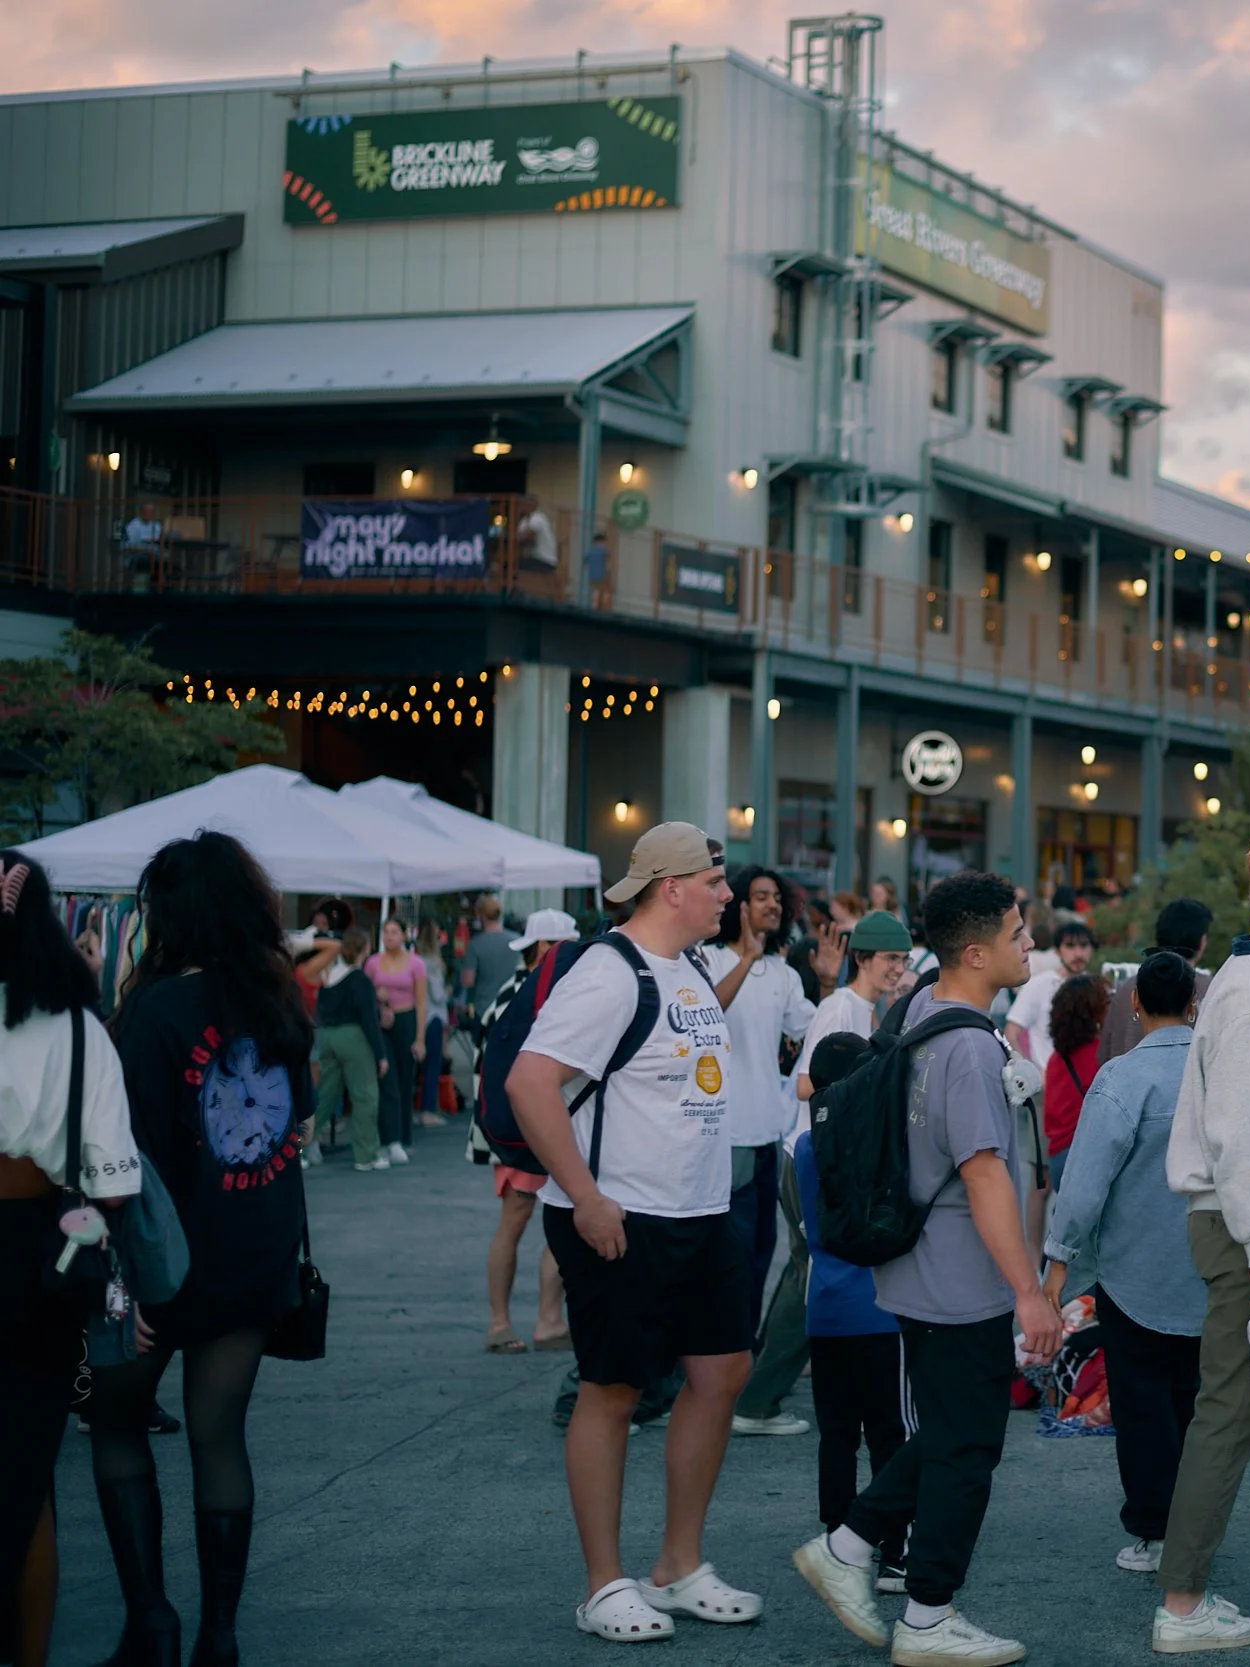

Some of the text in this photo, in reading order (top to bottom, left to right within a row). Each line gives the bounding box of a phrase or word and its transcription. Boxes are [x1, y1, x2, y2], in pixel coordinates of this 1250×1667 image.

[392, 138, 495, 167] BRICKLINE
[391, 160, 507, 191] GREENWAY
[667, 1002, 726, 1034] Coron
[688, 1029, 722, 1048] Extra
